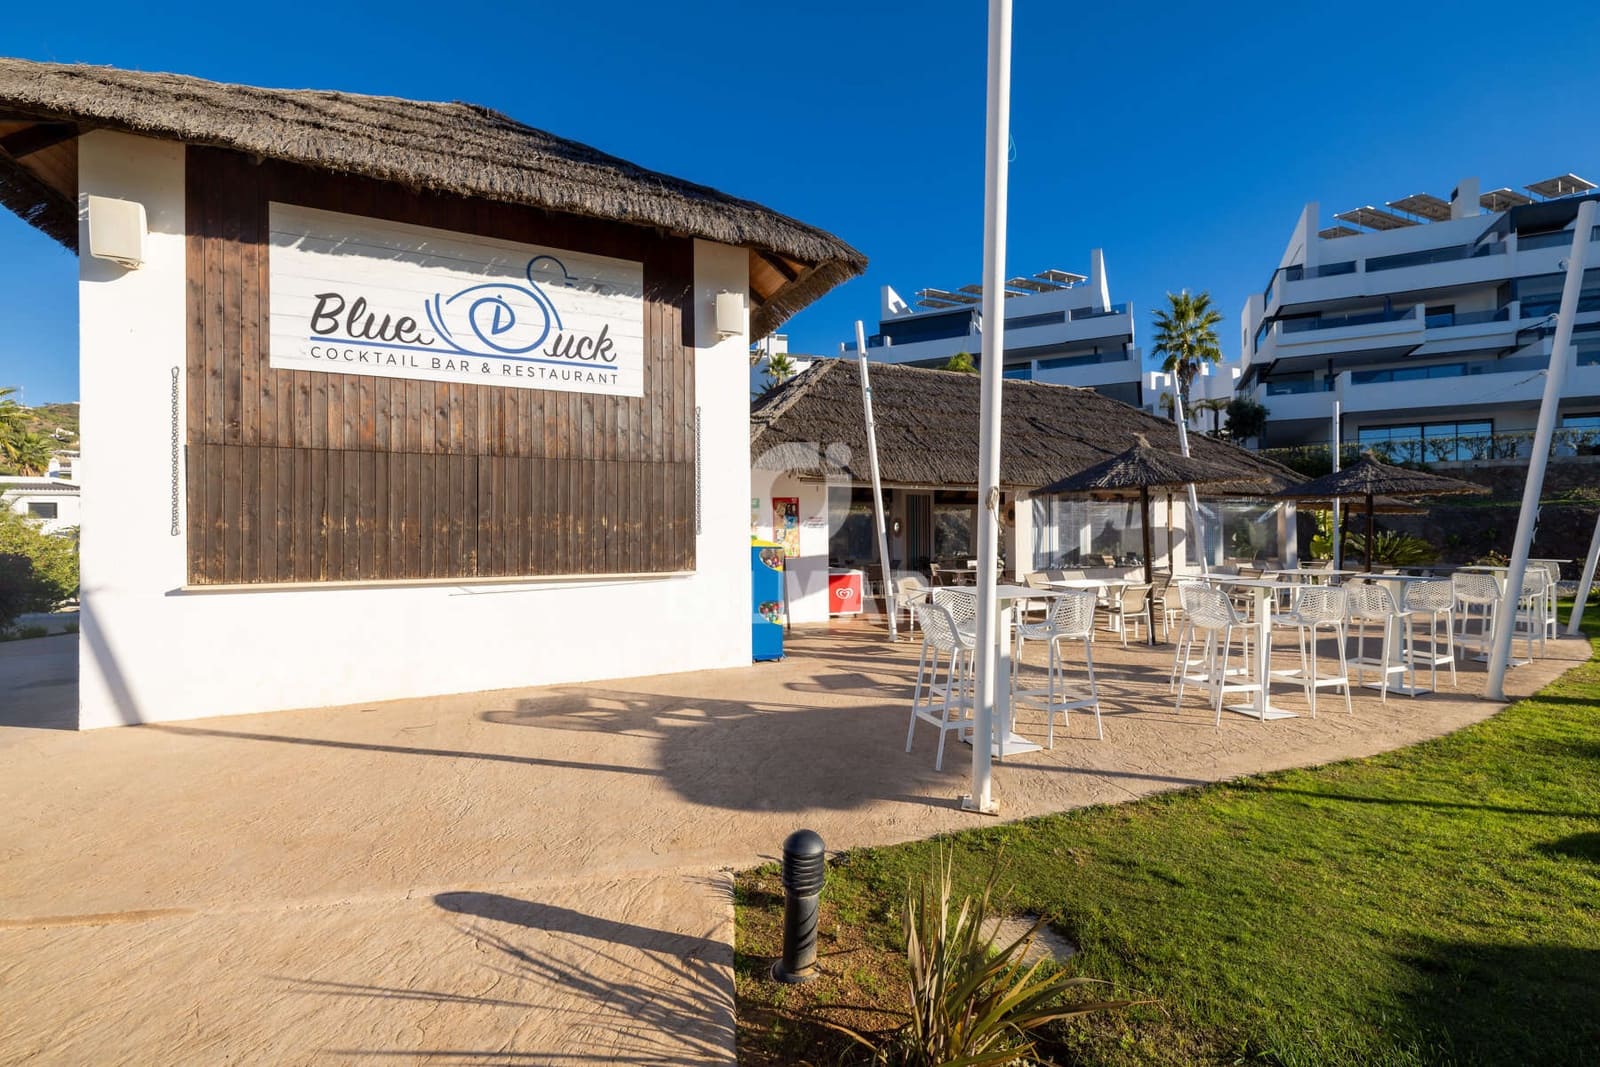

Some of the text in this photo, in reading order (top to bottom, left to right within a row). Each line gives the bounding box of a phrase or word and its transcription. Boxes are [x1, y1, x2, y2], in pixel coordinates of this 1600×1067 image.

[310, 292, 434, 345] Blue
[311, 345, 618, 385] COCKTAIL BAR & RESTAURANT
